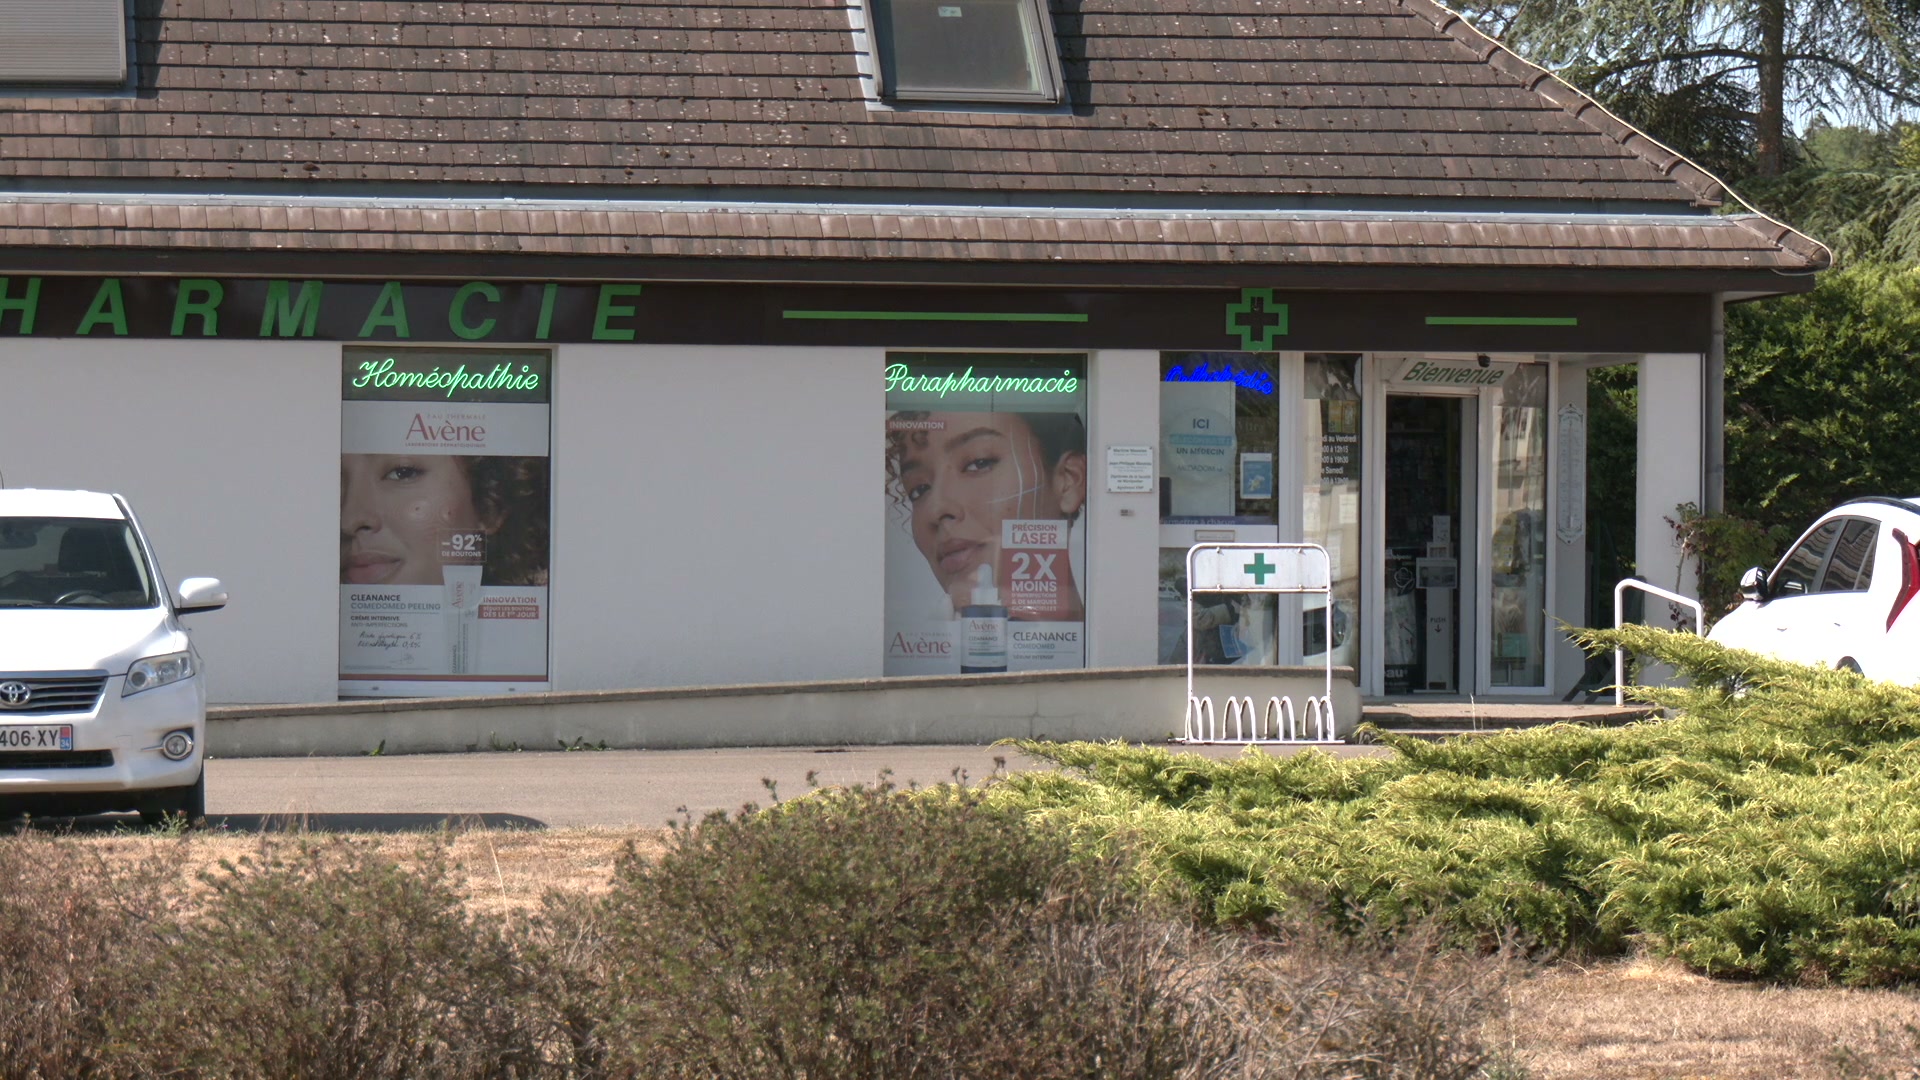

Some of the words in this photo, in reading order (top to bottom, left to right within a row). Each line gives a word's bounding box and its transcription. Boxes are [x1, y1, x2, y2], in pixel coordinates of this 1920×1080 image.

[352, 358, 539, 398] Homéopathie
[1402, 361, 1505, 385] Bienvenue
[884, 363, 1078, 399] Parapharmacie
[406, 413, 486, 442] Avène
[889, 421, 944, 429] INNOVATION
[1192, 418, 1209, 429] ICI
[1335, 434, 1357, 443] Vendredi
[1176, 447, 1188, 455] UN
[1190, 447, 1224, 456] MÉDECIN
[1325, 466, 1344, 474] Samedi
[1012, 522, 1057, 532] PRÉCISION
[1012, 532, 1057, 545] LASER
[1011, 552, 1057, 580] 2X
[1011, 581, 1057, 592] MOINS
[350, 593, 401, 602] CLEANANCE
[483, 596, 537, 604] INNOVATION
[350, 602, 406, 610] COMEDOMED
[1013, 631, 1078, 642] CLEANANCE
[889, 631, 952, 654] Avène
